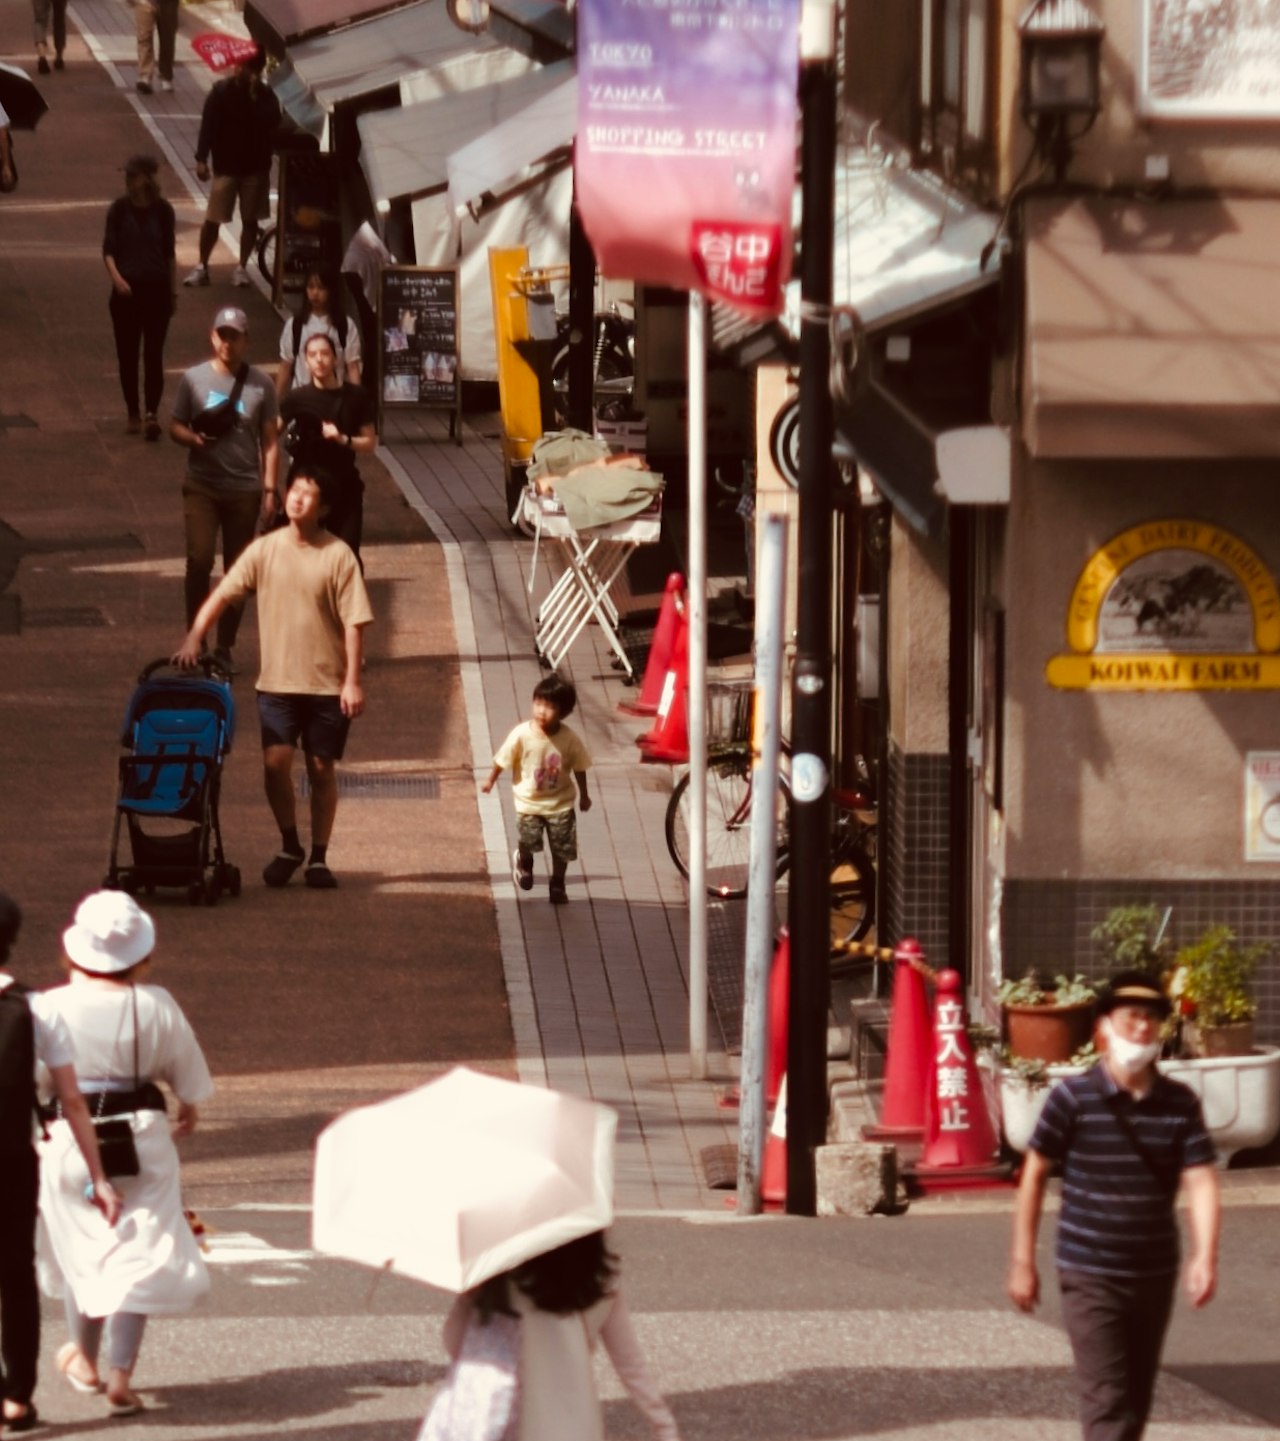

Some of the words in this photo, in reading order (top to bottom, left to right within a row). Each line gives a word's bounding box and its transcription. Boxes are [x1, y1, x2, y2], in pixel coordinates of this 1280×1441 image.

[589, 41, 653, 60] TOKYO
[587, 83, 666, 103] YANAKA
[586, 125, 686, 147] SHOPPING
[694, 127, 767, 150] STREET
[698, 230, 770, 263] 谷中
[1090, 661, 1181, 682] KOIWAI
[1191, 661, 1261, 682] FARM
[936, 1000, 971, 1130] 立入禁止
